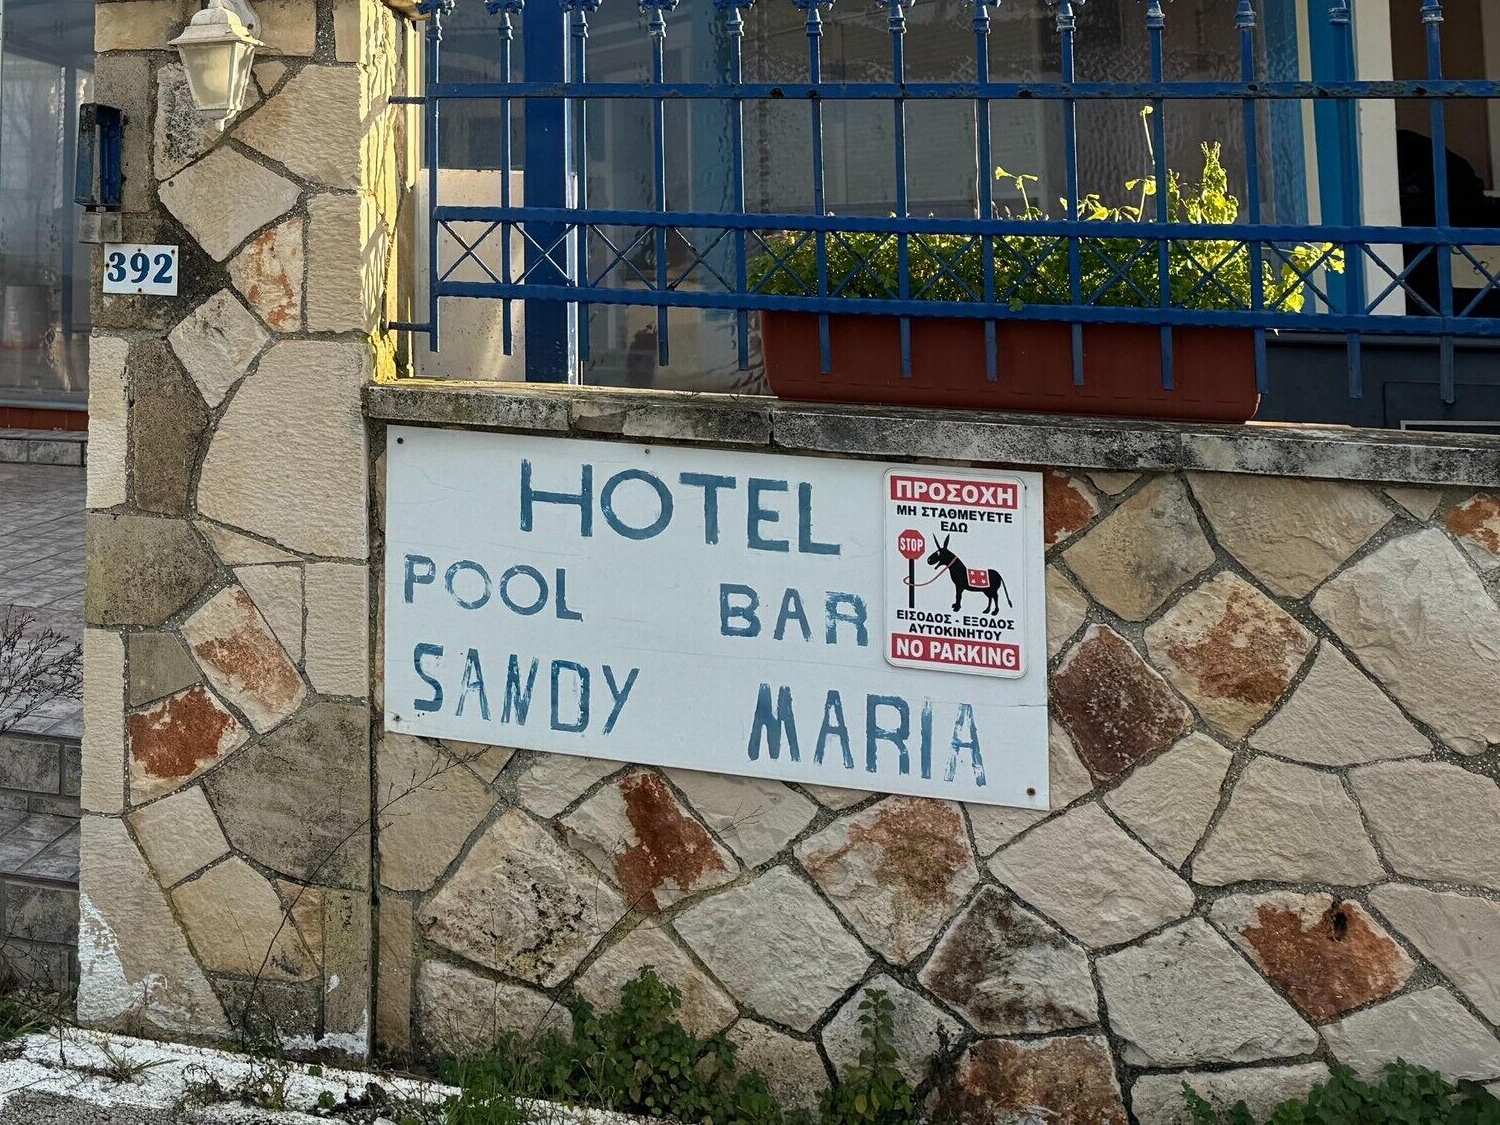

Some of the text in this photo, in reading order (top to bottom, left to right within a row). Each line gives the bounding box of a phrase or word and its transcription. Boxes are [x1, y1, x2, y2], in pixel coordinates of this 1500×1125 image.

[107, 251, 173, 284] 392
[896, 480, 1014, 507] ΠΡΟΣΟΧΗ
[520, 459, 841, 556] HOTEL
[896, 504, 1013, 524] ΜΗ ΣΤΑΘΜΕΥΕΤΕ
[940, 521, 968, 533] ΕΔΩ
[900, 537, 923, 552] STOP
[404, 554, 868, 647] POOL BAR
[896, 609, 952, 625] ΕΙΣΟΔΟΣ
[963, 615, 1015, 630] ΕΞΟΔΟΣ
[908, 622, 1003, 642] ΑΥΤΟΚΙΝΗΤΟΥ
[896, 638, 1016, 668] NO PARKING
[414, 642, 987, 787] SANDY MARIA
